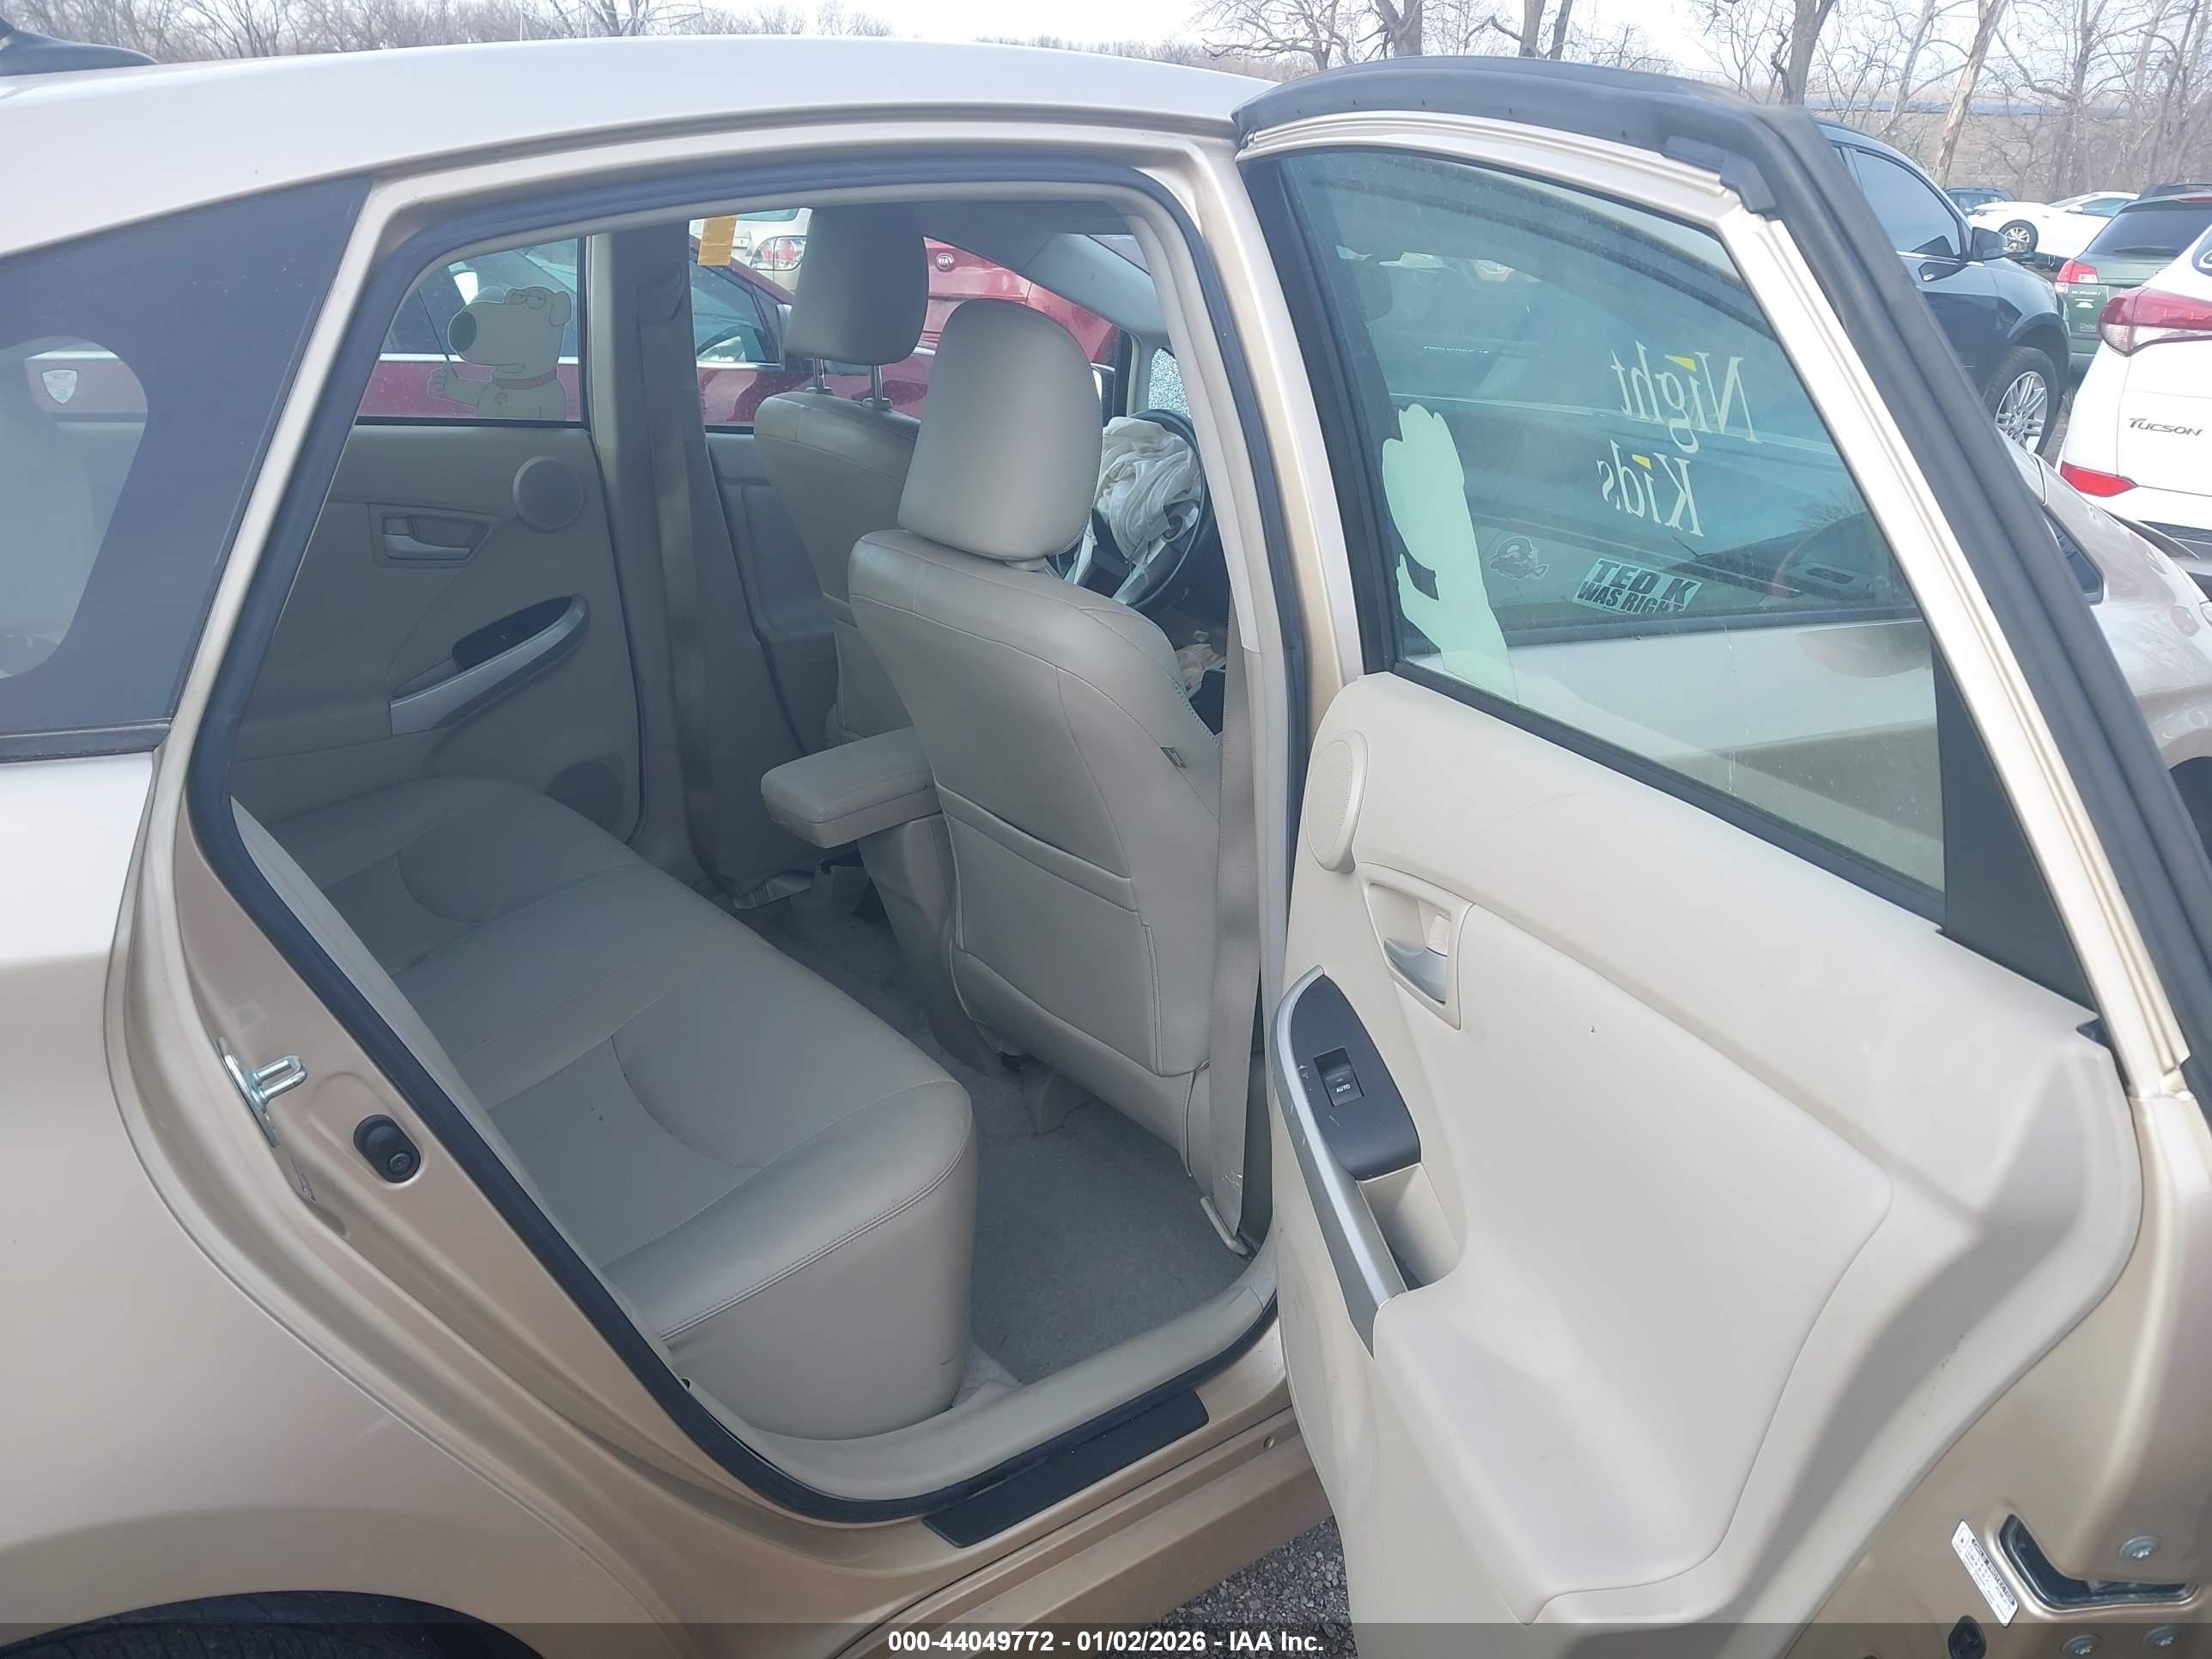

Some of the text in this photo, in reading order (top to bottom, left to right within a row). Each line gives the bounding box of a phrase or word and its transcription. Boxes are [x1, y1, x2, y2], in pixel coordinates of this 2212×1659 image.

[1577, 581, 1624, 607] WAS
[1592, 559, 1698, 605] TED K
[1336, 1084, 1351, 1093] AUTO
